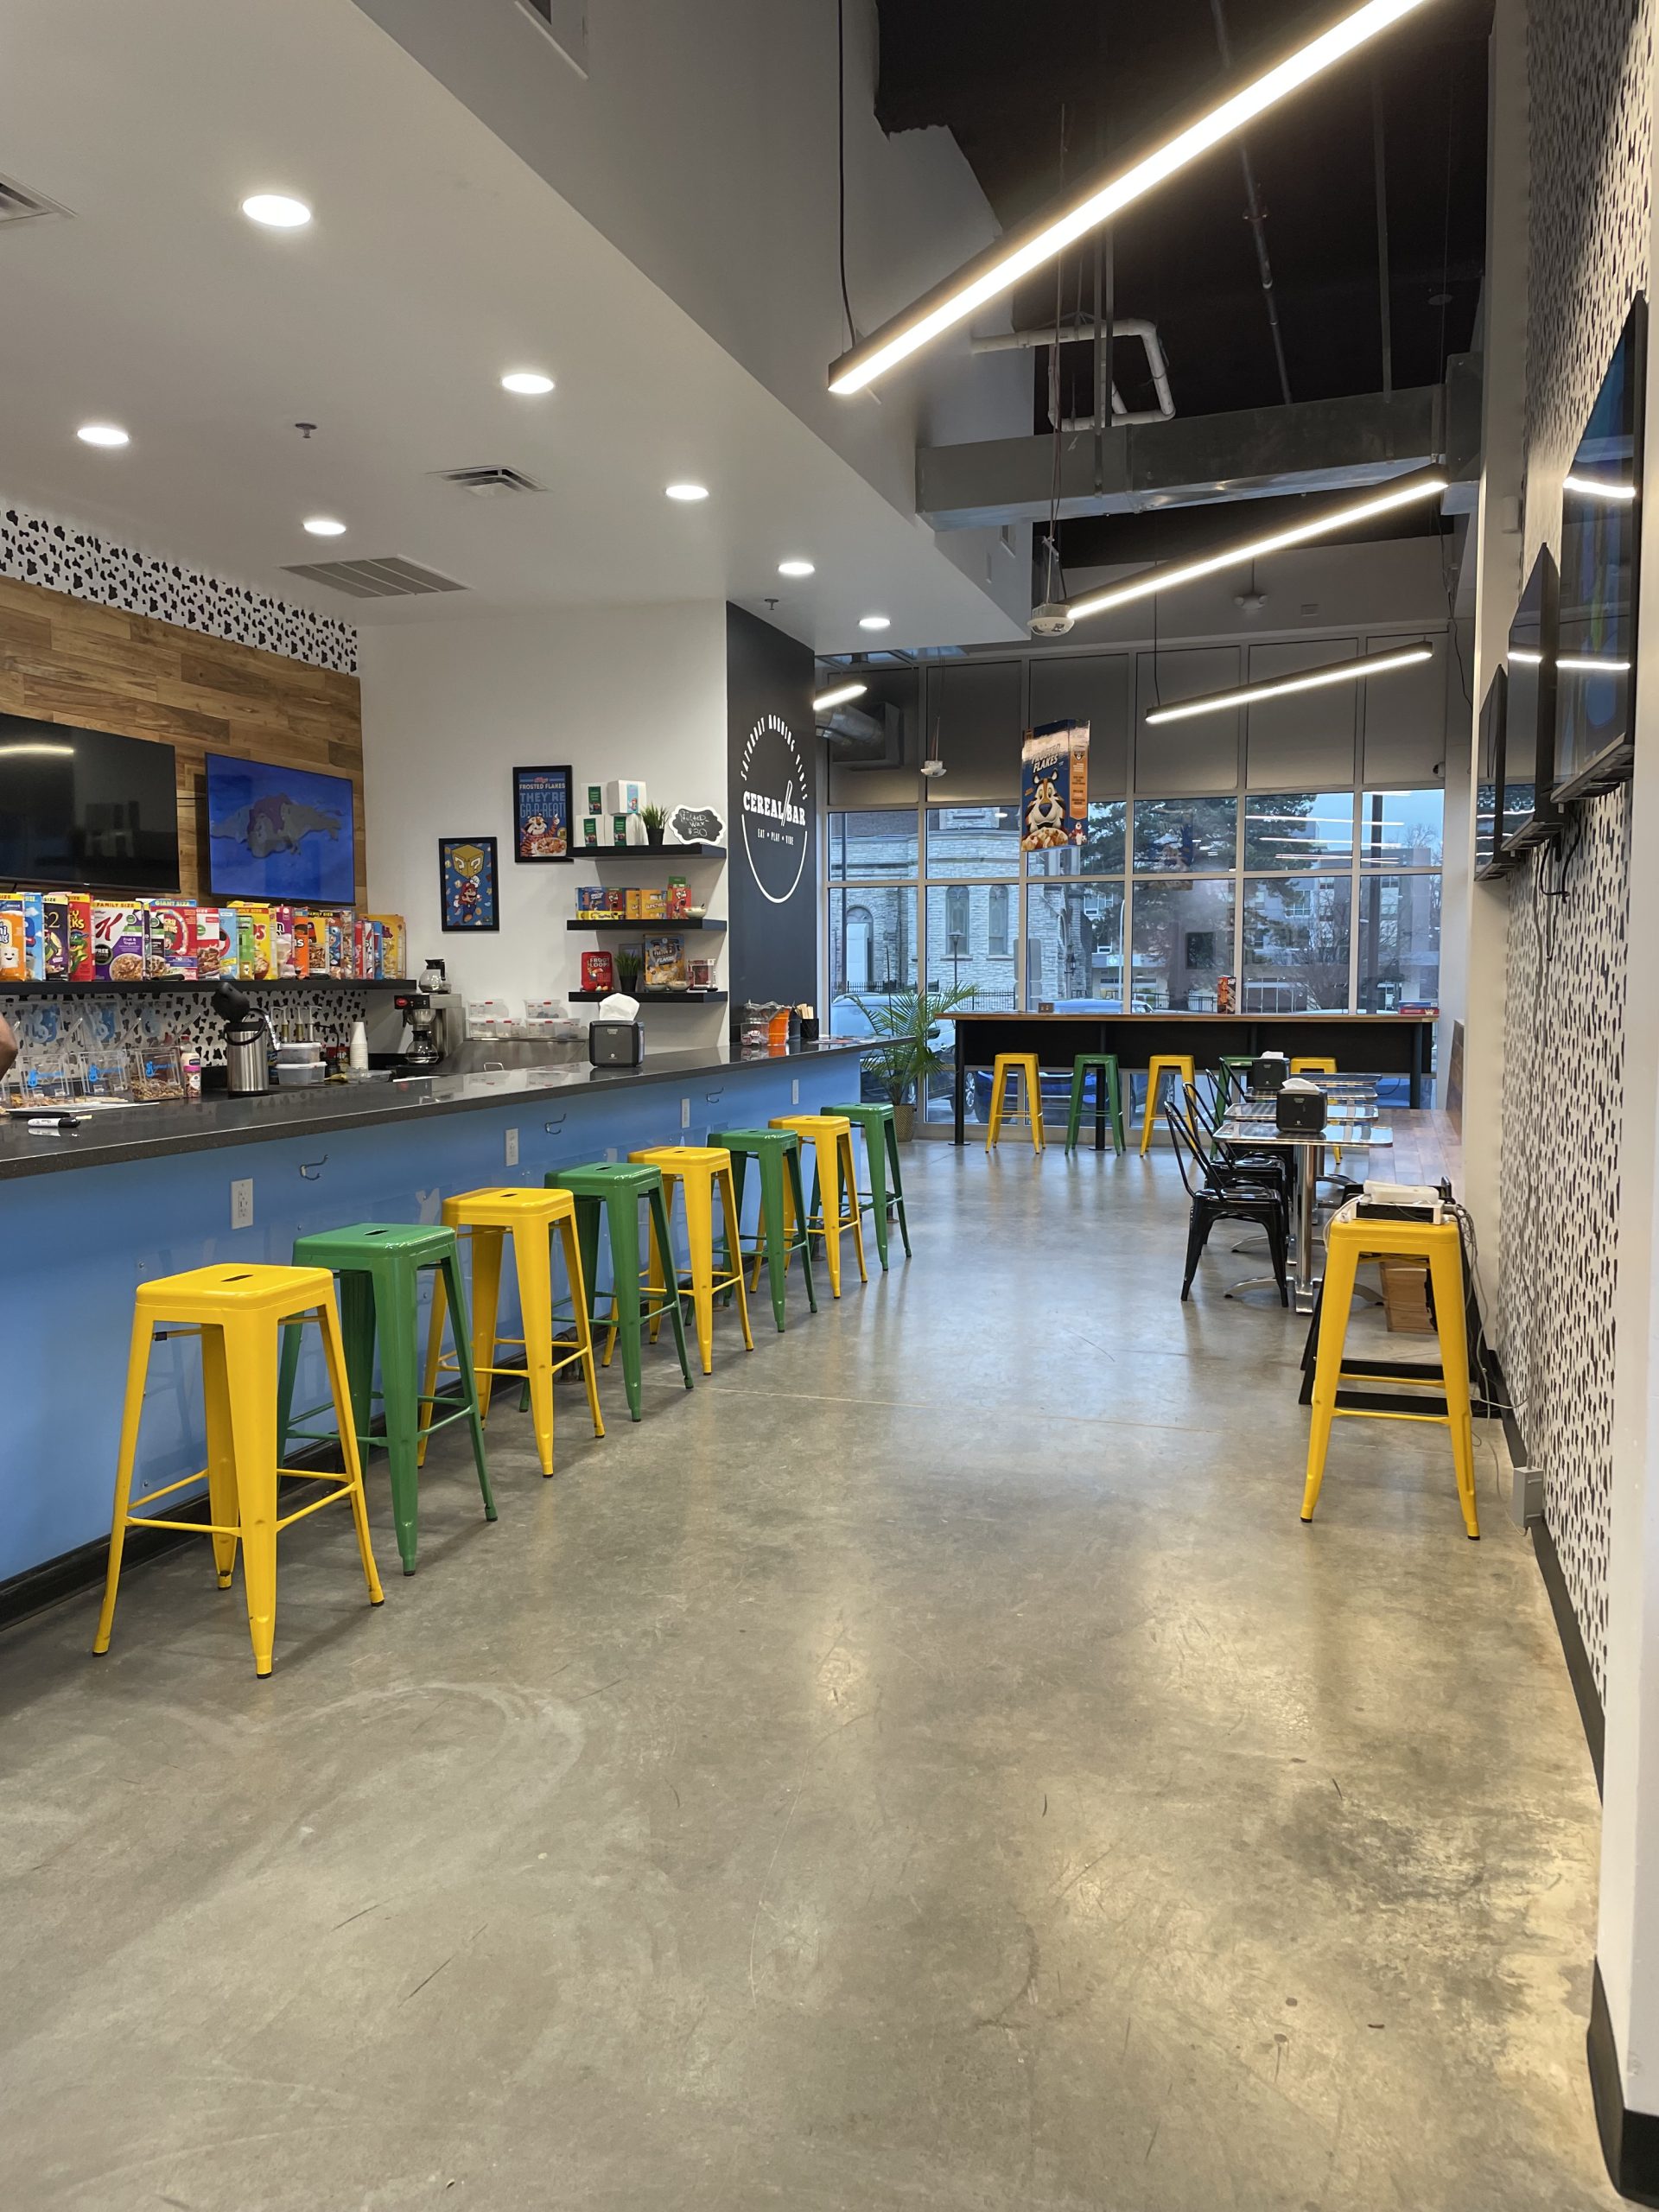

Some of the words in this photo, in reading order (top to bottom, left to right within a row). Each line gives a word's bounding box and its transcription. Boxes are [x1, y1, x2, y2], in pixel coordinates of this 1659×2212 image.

[1033, 753, 1059, 773] FLAKES
[795, 753, 808, 800] VIBES
[519, 791, 566, 803] THEY'RE
[743, 790, 784, 820] CEREAL
[785, 804, 806, 826] BAR
[785, 835, 794, 846] VIBE
